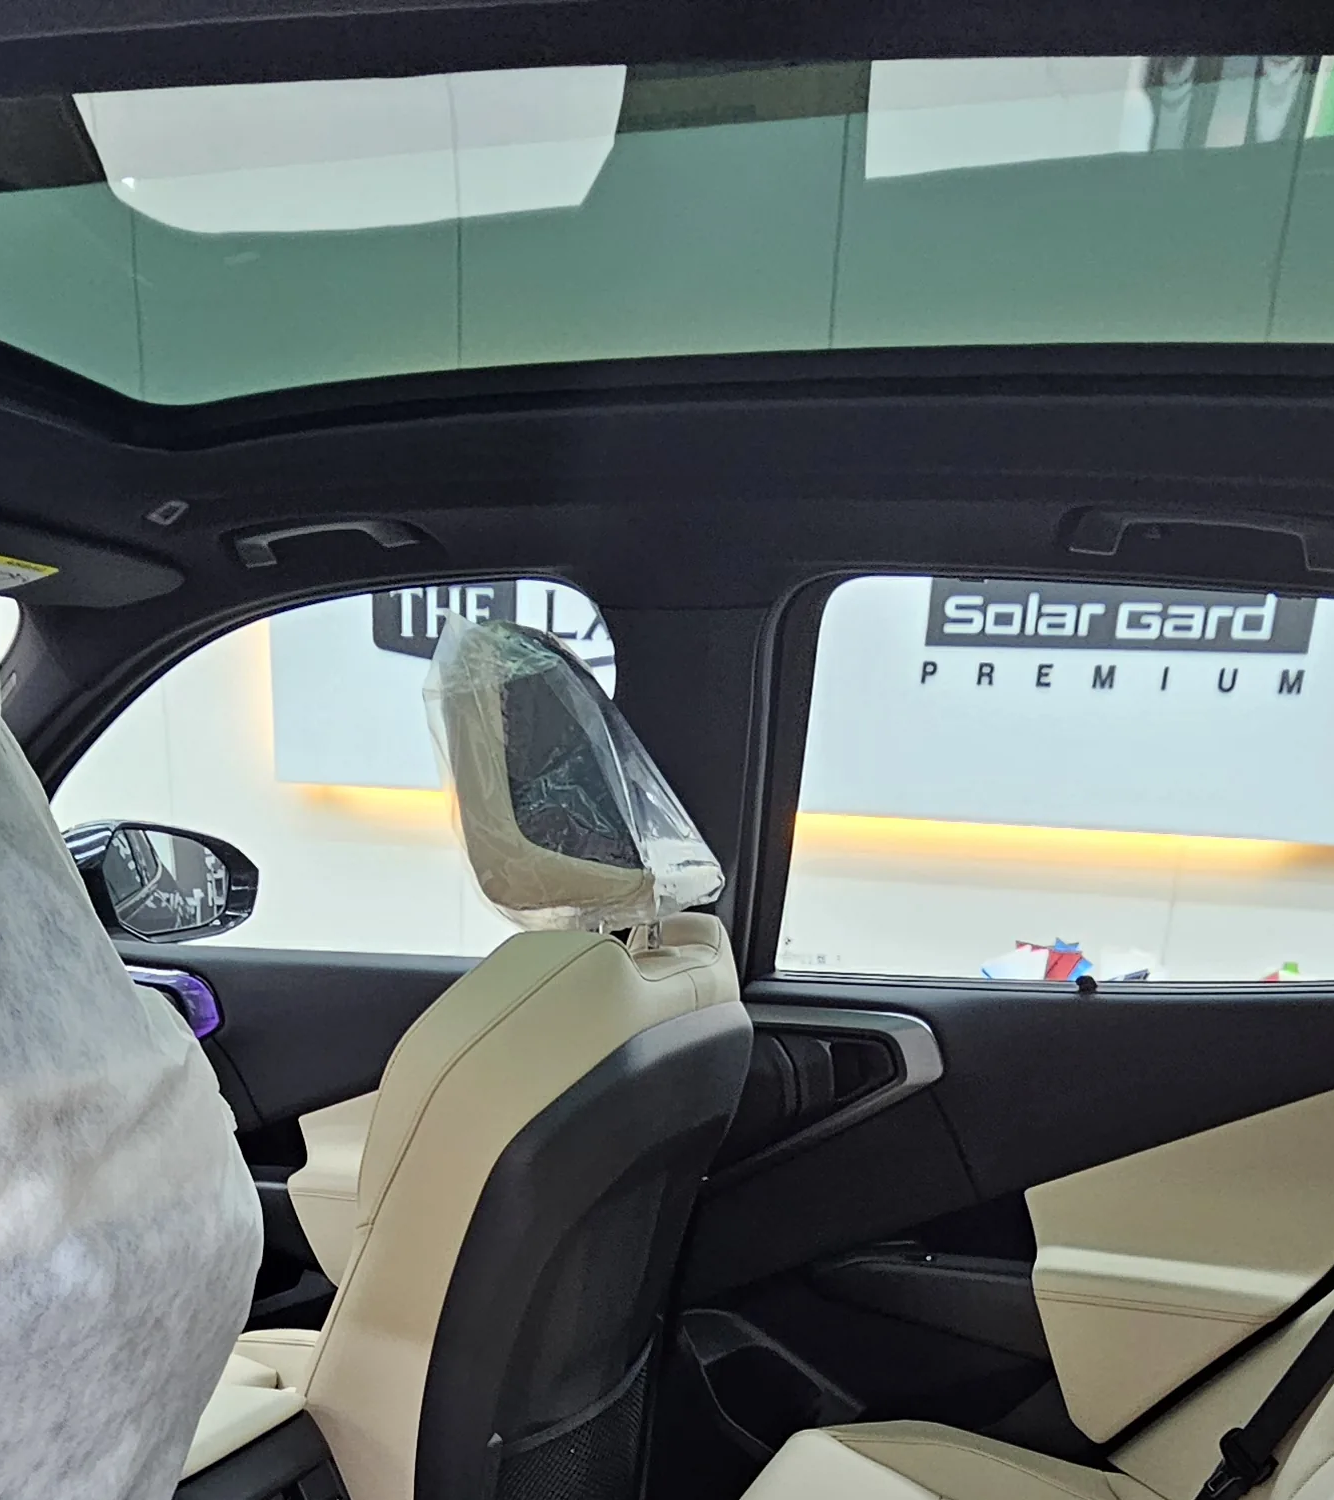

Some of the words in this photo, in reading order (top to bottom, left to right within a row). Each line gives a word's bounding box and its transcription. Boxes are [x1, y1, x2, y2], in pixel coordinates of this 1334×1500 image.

[389, 585, 495, 638] THE
[943, 592, 1106, 637] Solar
[1115, 593, 1279, 640] Gard
[920, 660, 1305, 695] PREMIUM
